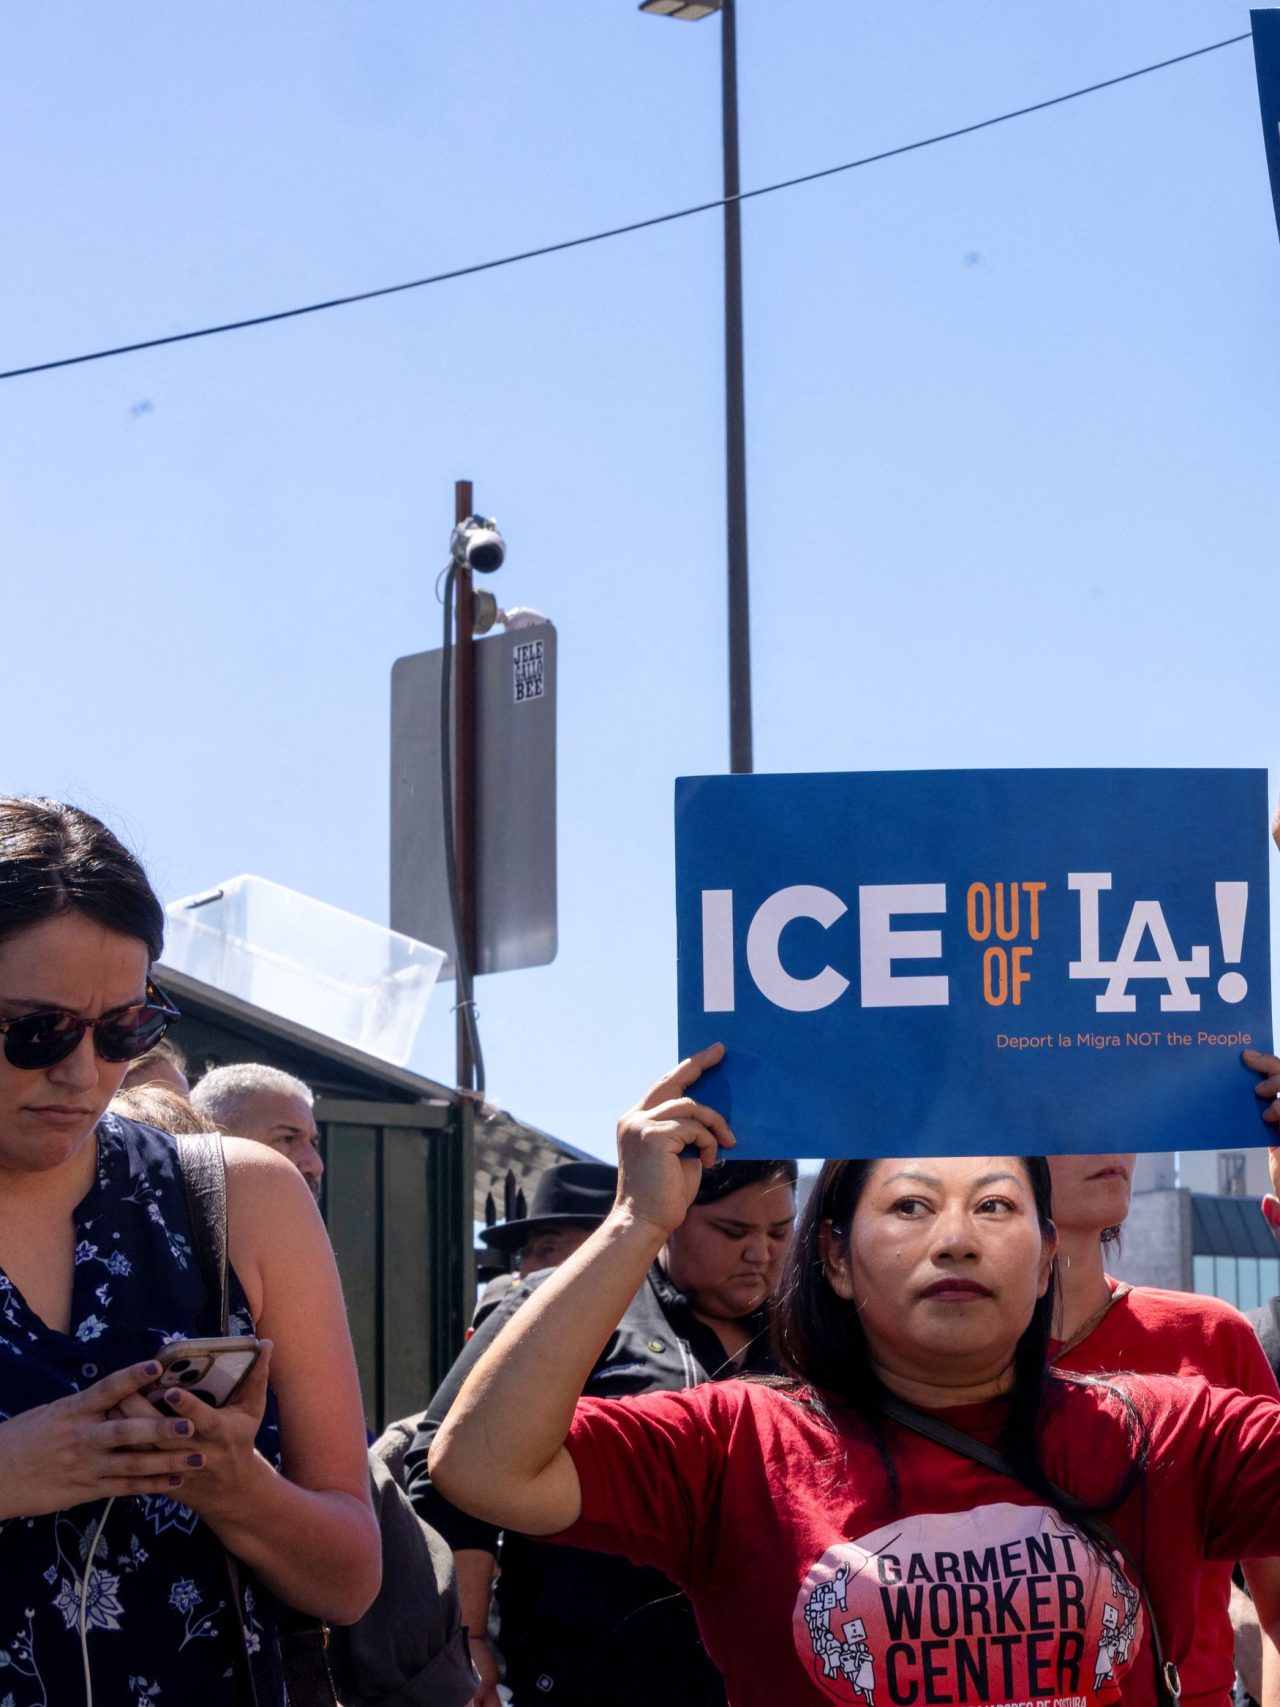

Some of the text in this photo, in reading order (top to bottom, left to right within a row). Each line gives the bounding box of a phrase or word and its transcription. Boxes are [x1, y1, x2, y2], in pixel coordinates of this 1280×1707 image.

[966, 881, 1047, 942] OUT
[1067, 871, 1249, 1012] LA!
[701, 883, 949, 1012] ICE
[983, 946, 1033, 1007] OF
[996, 1031, 1252, 1049] Deport la Migra NOT the People
[877, 1532, 1076, 1585] GARMENT
[879, 1574, 1086, 1641] WORKER
[886, 1631, 1085, 1706] CENTER
